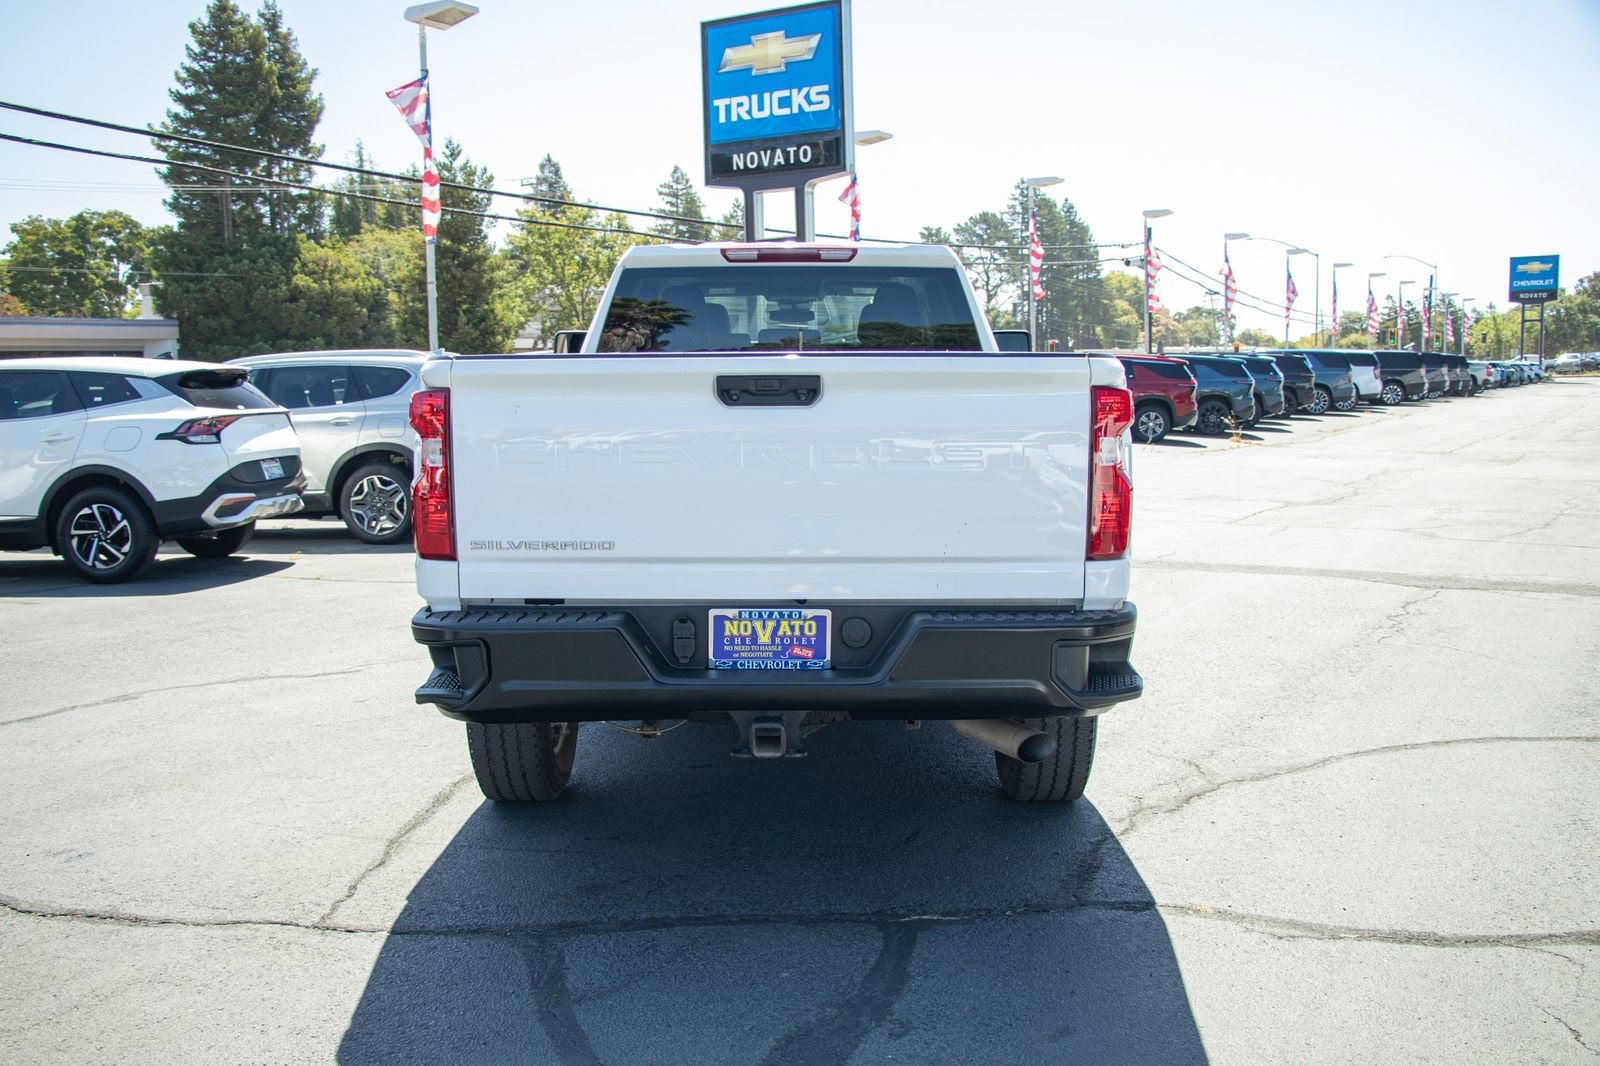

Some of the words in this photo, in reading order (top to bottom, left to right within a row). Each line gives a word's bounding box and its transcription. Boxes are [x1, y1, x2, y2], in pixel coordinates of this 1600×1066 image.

[713, 84, 830, 124] TRUCKS
[732, 145, 812, 170] NOVATO
[470, 540, 615, 551] SILVERADO
[741, 611, 800, 619] NOVATO
[723, 620, 817, 644] NOVATO
[737, 661, 802, 669] CHEVROLET
